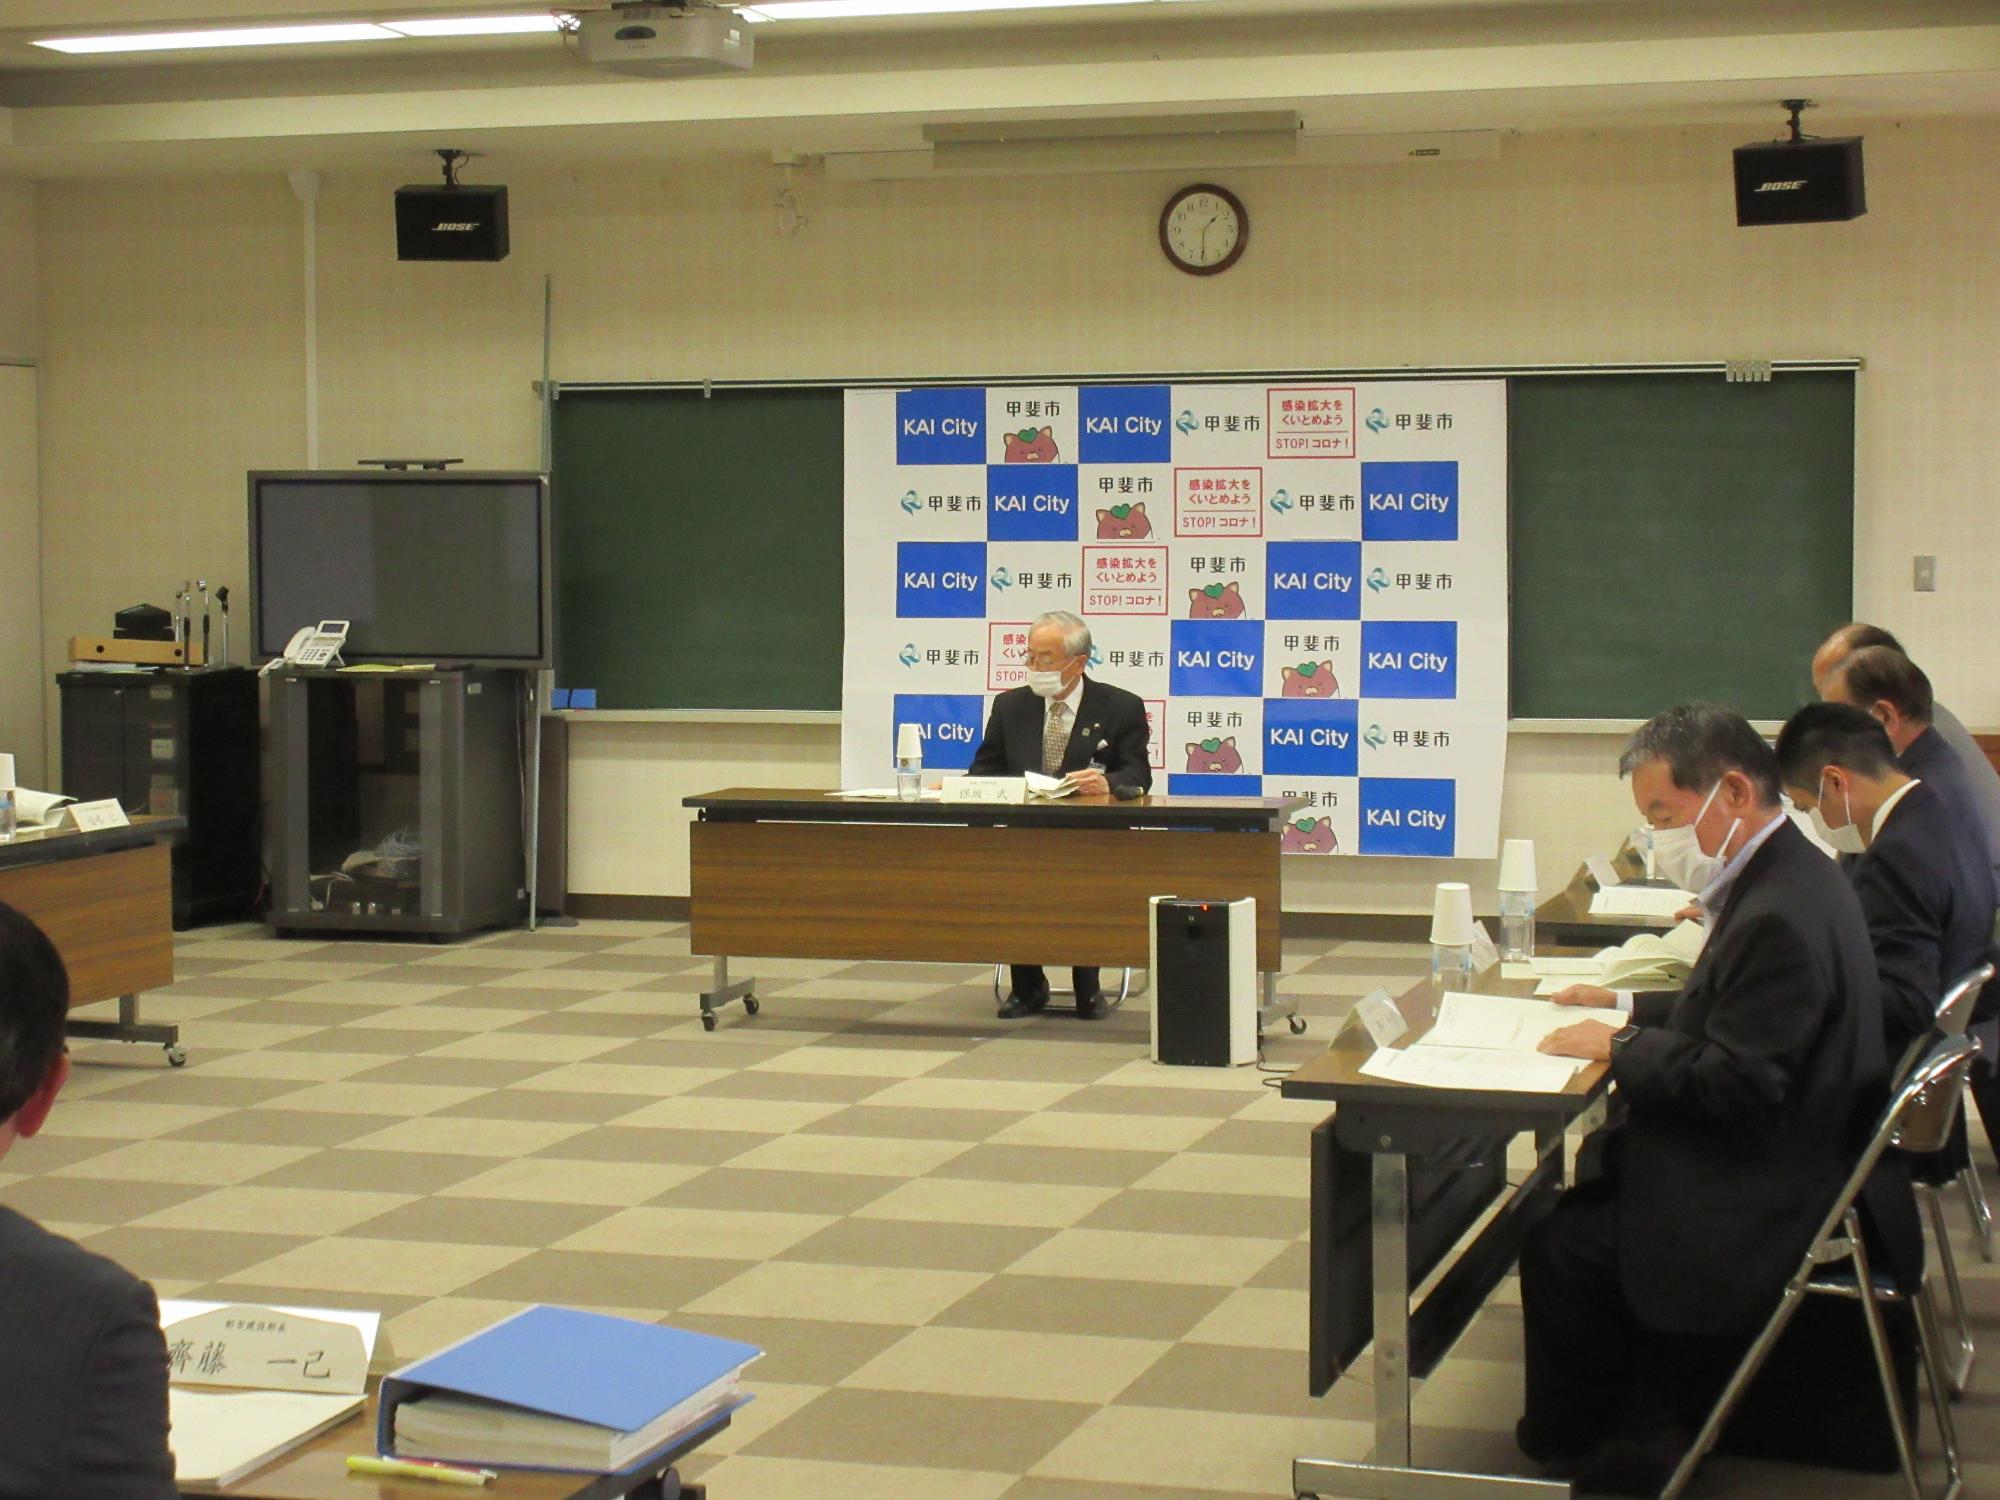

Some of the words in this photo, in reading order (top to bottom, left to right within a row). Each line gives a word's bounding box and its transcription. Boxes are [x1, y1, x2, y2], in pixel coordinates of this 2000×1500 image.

[1754, 181, 1808, 192] BOSE
[432, 223, 480, 231] BOSE
[1007, 401, 1059, 417] 甲斐市
[1282, 400, 1342, 411] 感染拡大を
[905, 419, 934, 435] KAI
[942, 418, 977, 437] City
[1087, 417, 1117, 433] KAI
[1125, 416, 1161, 435] City
[1205, 416, 1259, 432] 甲斐市
[1282, 414, 1343, 425] くいとめよう
[1396, 413, 1452, 430] 甲斐市
[1277, 438, 1308, 449] STOP!
[1099, 477, 1152, 493] 甲斐市
[1190, 479, 1250, 490] 感染拡大を
[929, 496, 980, 511] 甲斐市
[995, 496, 1026, 511] KAI
[1033, 495, 1069, 514] City
[1189, 493, 1250, 504] くいとめよう
[1300, 495, 1354, 511] 甲斐市
[1370, 494, 1402, 510] KAI
[1411, 493, 1449, 512] City
[1183, 517, 1216, 527] STOP!
[1097, 557, 1156, 569] 感染拡大を
[1191, 557, 1245, 573] 甲斐市
[905, 573, 934, 588] KAI
[942, 572, 977, 591] City
[1019, 573, 1071, 588] 甲斐市
[1096, 571, 1156, 584] くいとめよう
[1274, 573, 1306, 589] KAI
[1314, 573, 1352, 592] City
[1397, 573, 1451, 590] 甲斐市
[1090, 595, 1122, 606] STOP!
[1285, 635, 1339, 651] 甲斐市
[927, 650, 978, 665] 甲斐市
[1110, 651, 1163, 667] 甲斐市
[1178, 651, 1209, 667] KAI
[1218, 651, 1254, 670] City
[1369, 653, 1401, 669] KAI
[1409, 653, 1447, 672] City
[995, 671, 1028, 682] STOP!
[1188, 712, 1242, 728] 甲斐市
[918, 723, 931, 740] AI
[938, 723, 974, 742] City
[1271, 729, 1303, 745] KAI
[1311, 729, 1348, 748] City
[1394, 731, 1449, 747] 甲斐市
[1368, 810, 1400, 826] KAI
[1408, 810, 1446, 830] City
